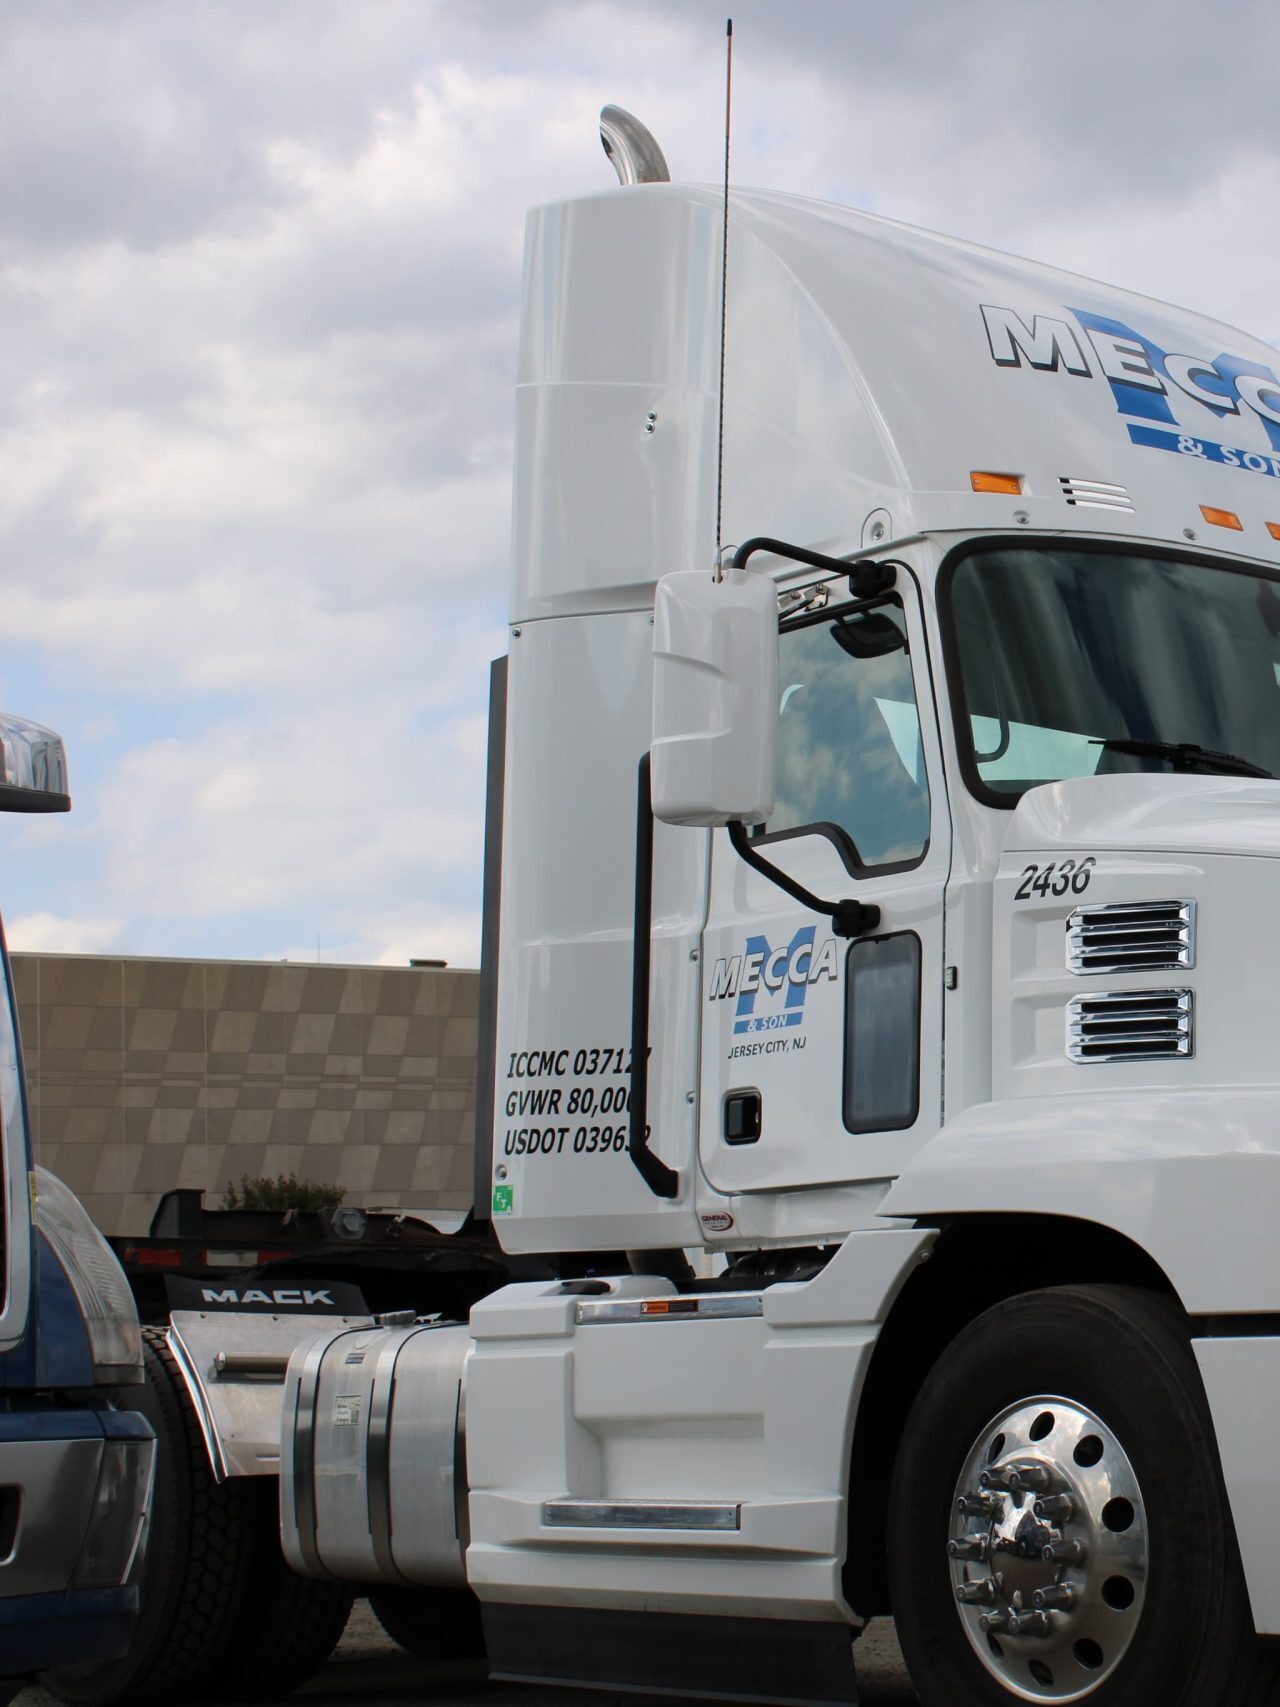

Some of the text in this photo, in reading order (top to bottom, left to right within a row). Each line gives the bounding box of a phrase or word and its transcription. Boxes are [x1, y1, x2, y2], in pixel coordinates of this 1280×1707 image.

[1177, 435, 1207, 460] &
[1014, 856, 1097, 901] 2436
[709, 938, 838, 1001] MECCA
[747, 1014, 788, 1032] & SON
[728, 1036, 807, 1059] JERSEY CITY, NJ
[507, 1050, 569, 1078] ICCMC
[505, 1088, 562, 1117] GVWR
[505, 1124, 652, 1156] USDOT 0396
[200, 1288, 335, 1305] MACK
